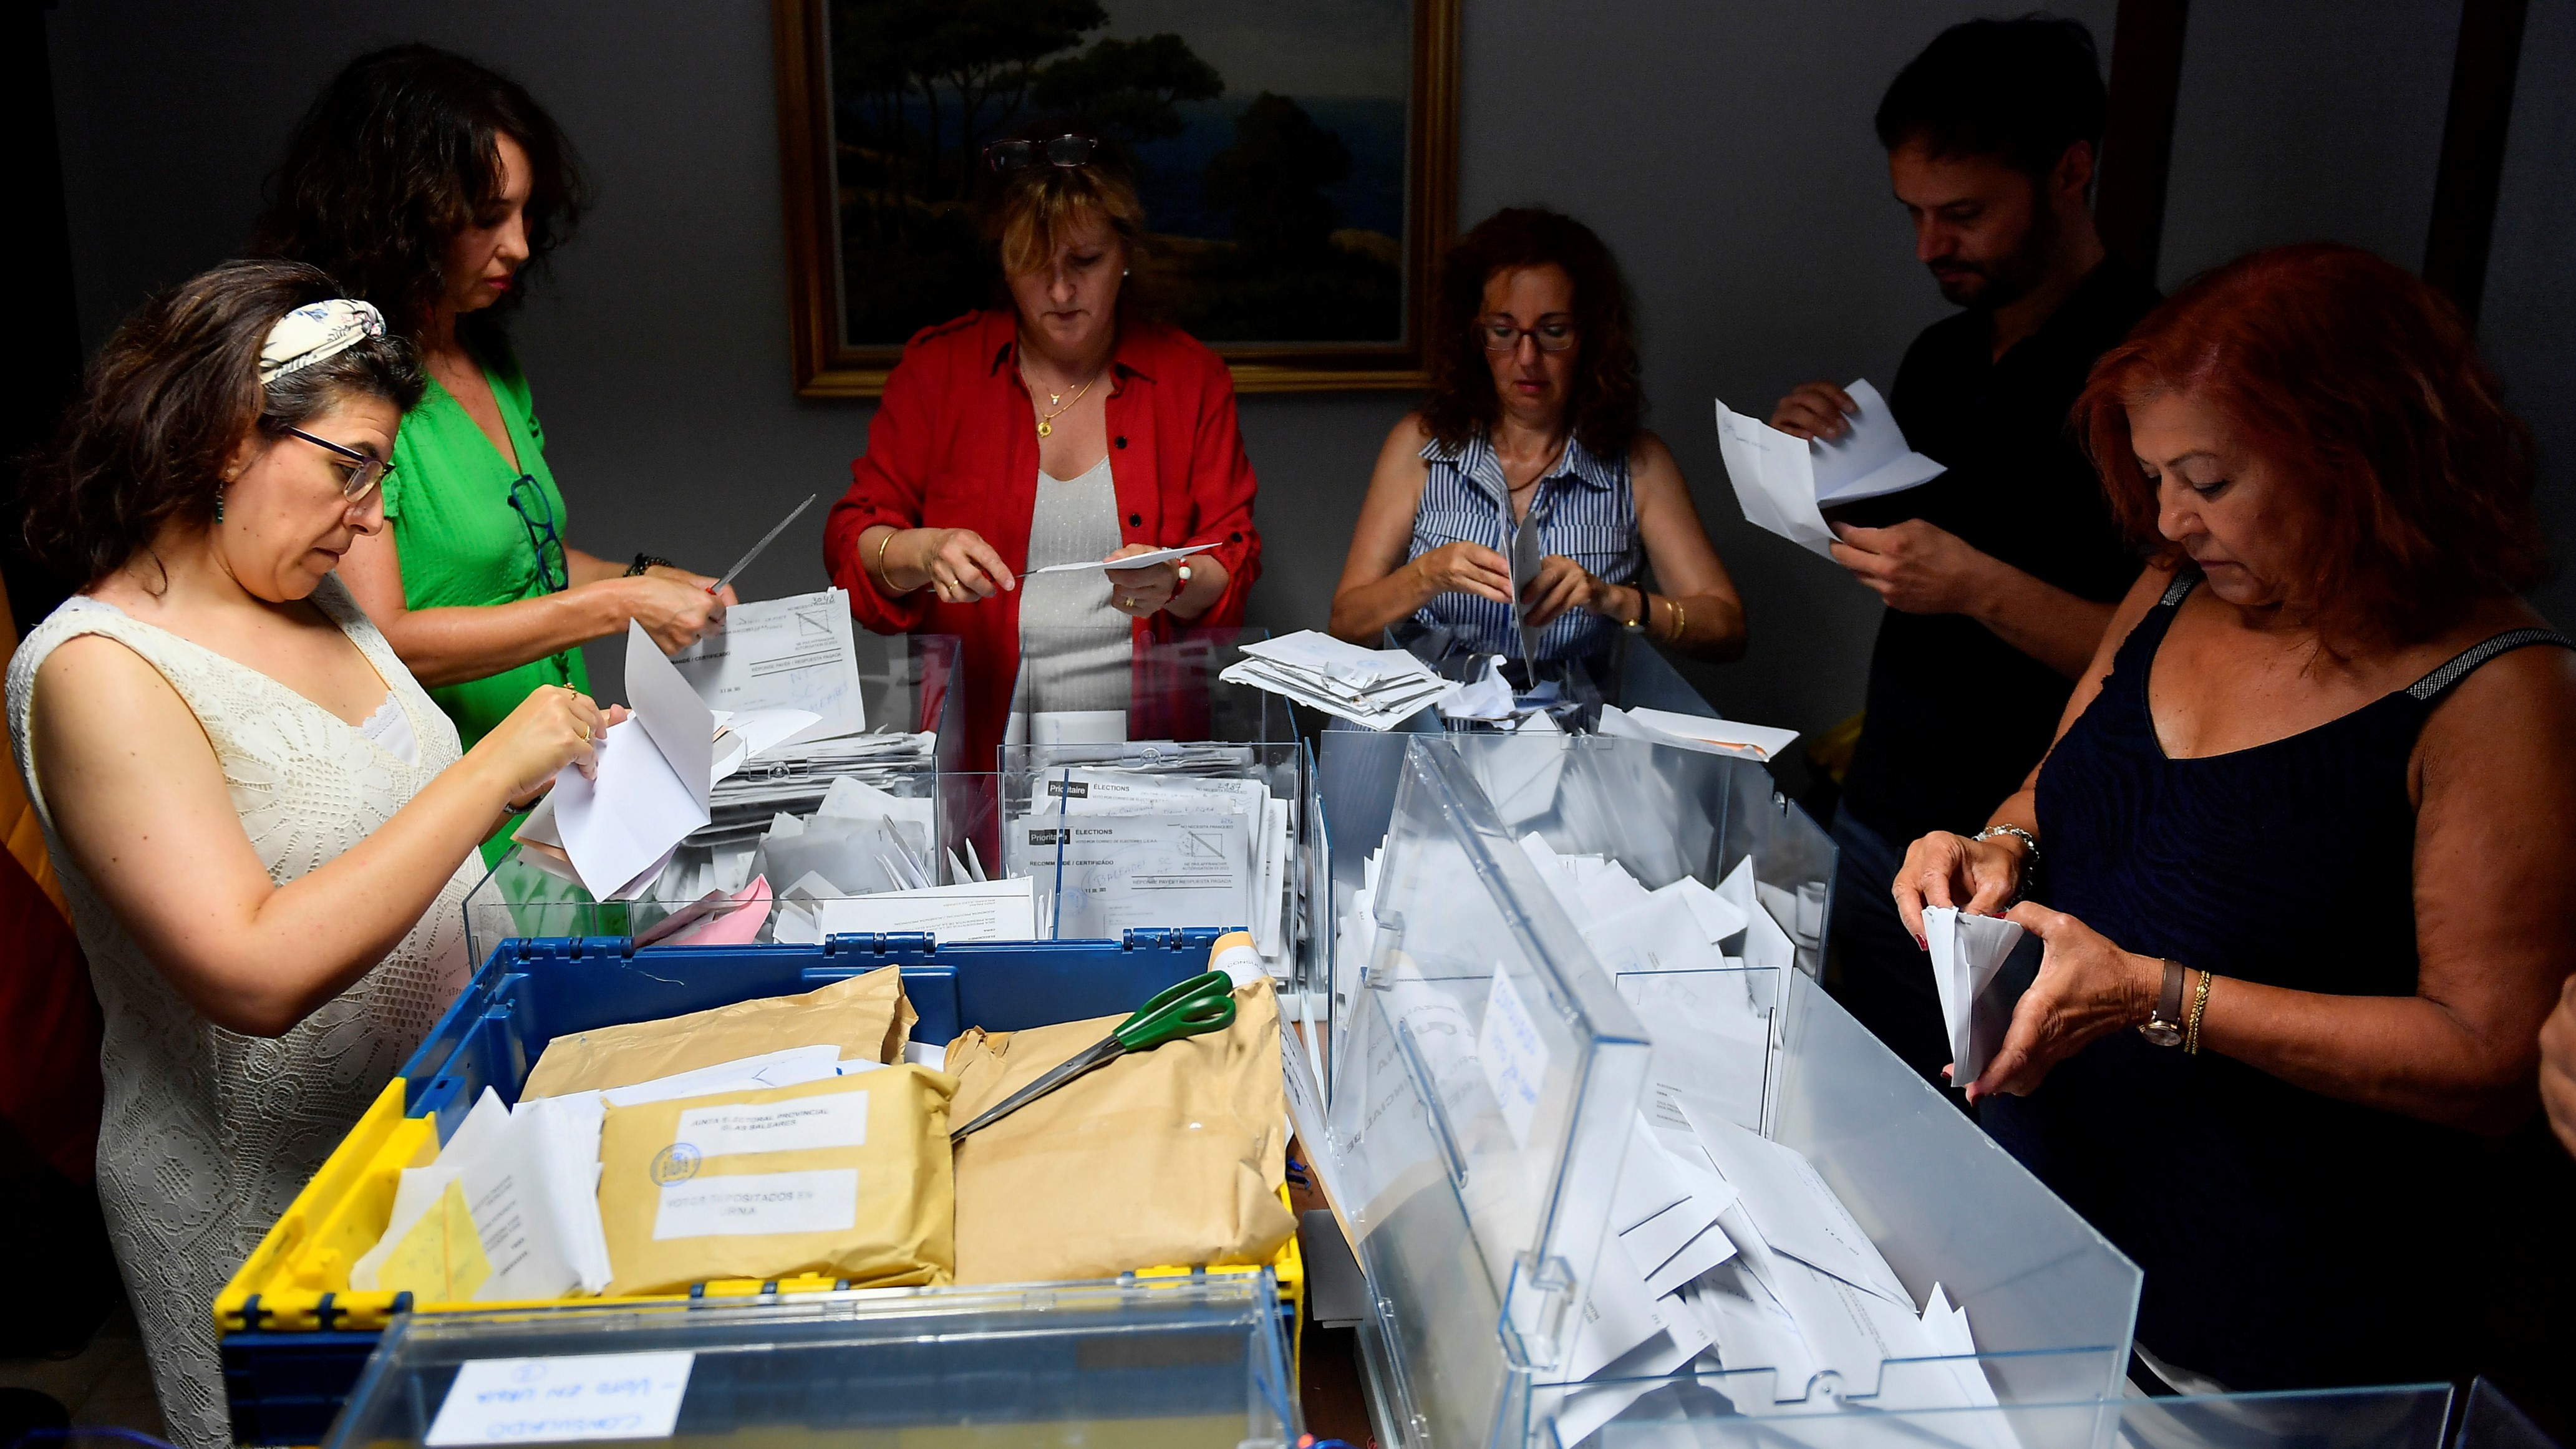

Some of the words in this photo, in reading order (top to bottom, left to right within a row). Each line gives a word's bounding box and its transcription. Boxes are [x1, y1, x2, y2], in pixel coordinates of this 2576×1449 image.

[694, 651, 731, 662] CERTIFICADO
[795, 656, 822, 665] RESPUESTA
[823, 652, 841, 660] PAGADA
[1093, 783, 1130, 792] ÉLECTIONS
[777, 1108, 830, 1120] PROVINCIAL
[748, 1120, 797, 1131] BALEARES
